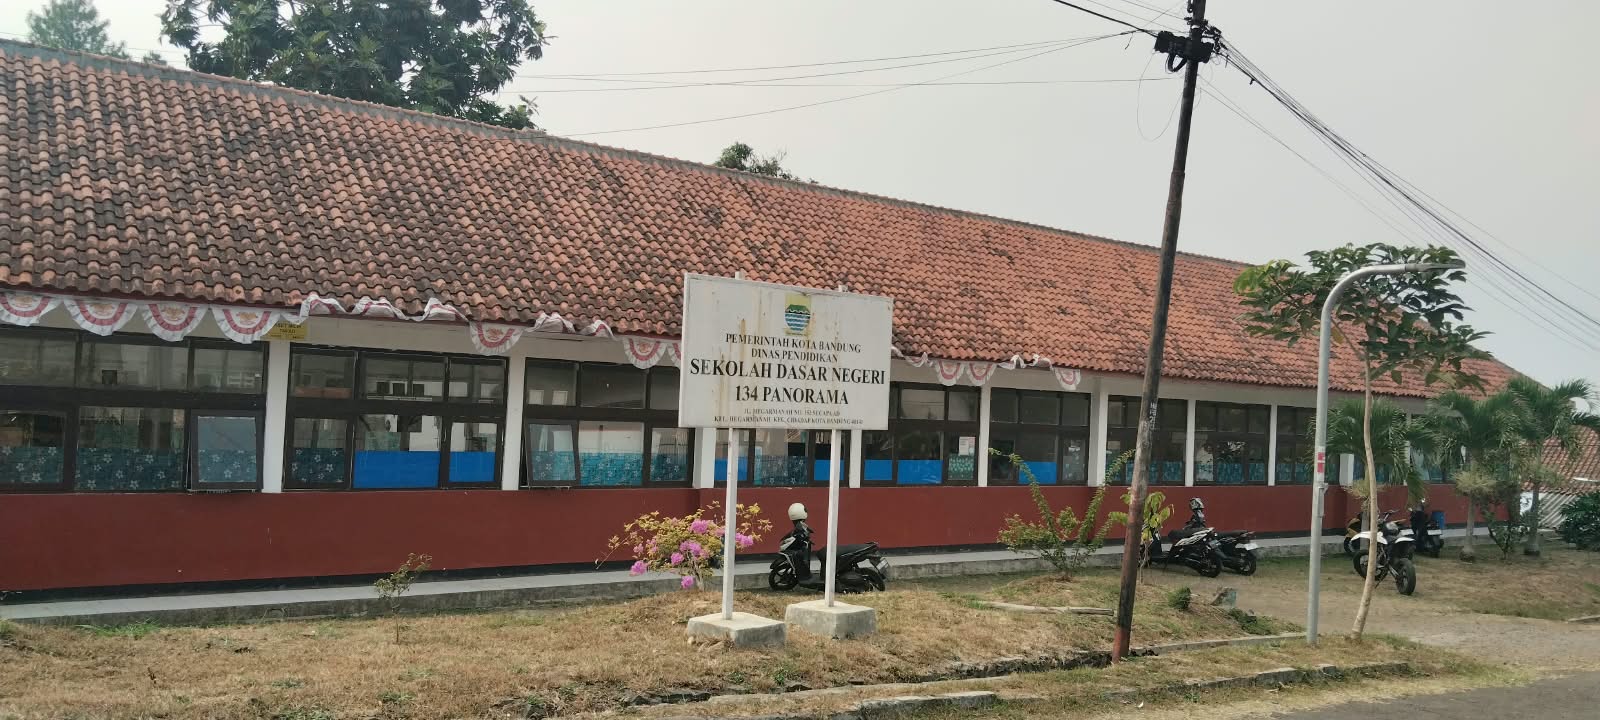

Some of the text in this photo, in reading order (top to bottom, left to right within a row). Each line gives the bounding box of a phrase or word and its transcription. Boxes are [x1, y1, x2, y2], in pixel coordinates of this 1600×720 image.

[725, 333, 789, 348] PEMERINTAH
[792, 338, 817, 350] KOTA
[819, 341, 862, 353] BANDUNG
[751, 347, 839, 363] DINAS PENDIDIKAN
[690, 358, 886, 385] SEKOLAH DASAR NEGERI
[735, 385, 849, 405] 134 PANORAMA
[826, 417, 850, 425] BANDUNG
